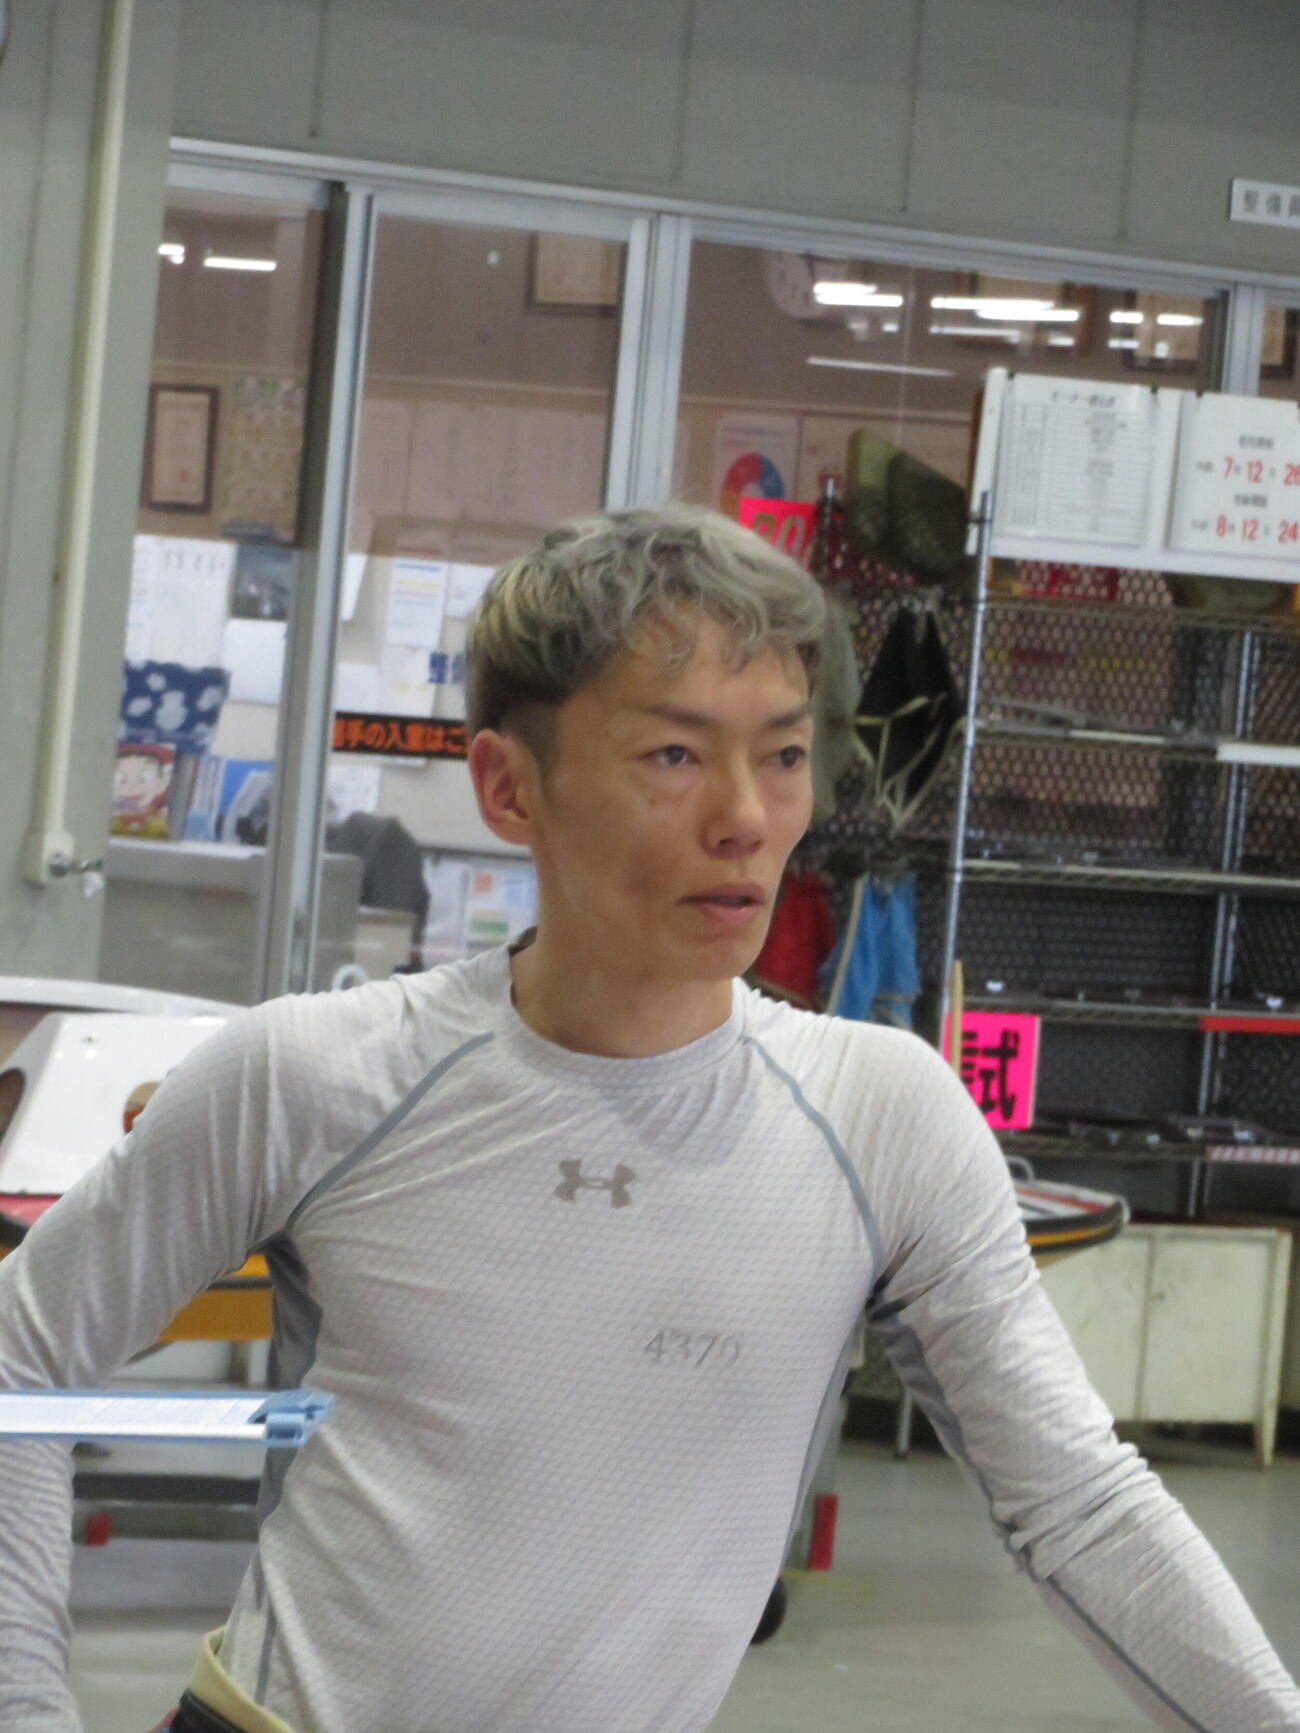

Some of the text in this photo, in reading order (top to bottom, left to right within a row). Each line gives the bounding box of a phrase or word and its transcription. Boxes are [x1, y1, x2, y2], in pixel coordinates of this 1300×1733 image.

[1223, 456, 1234, 479] 7
[1246, 460, 1264, 483] 12
[1216, 514, 1227, 538] 8
[1241, 518, 1259, 541] 12
[1278, 520, 1298, 543] 24
[642, 1330, 740, 1368] 4370
